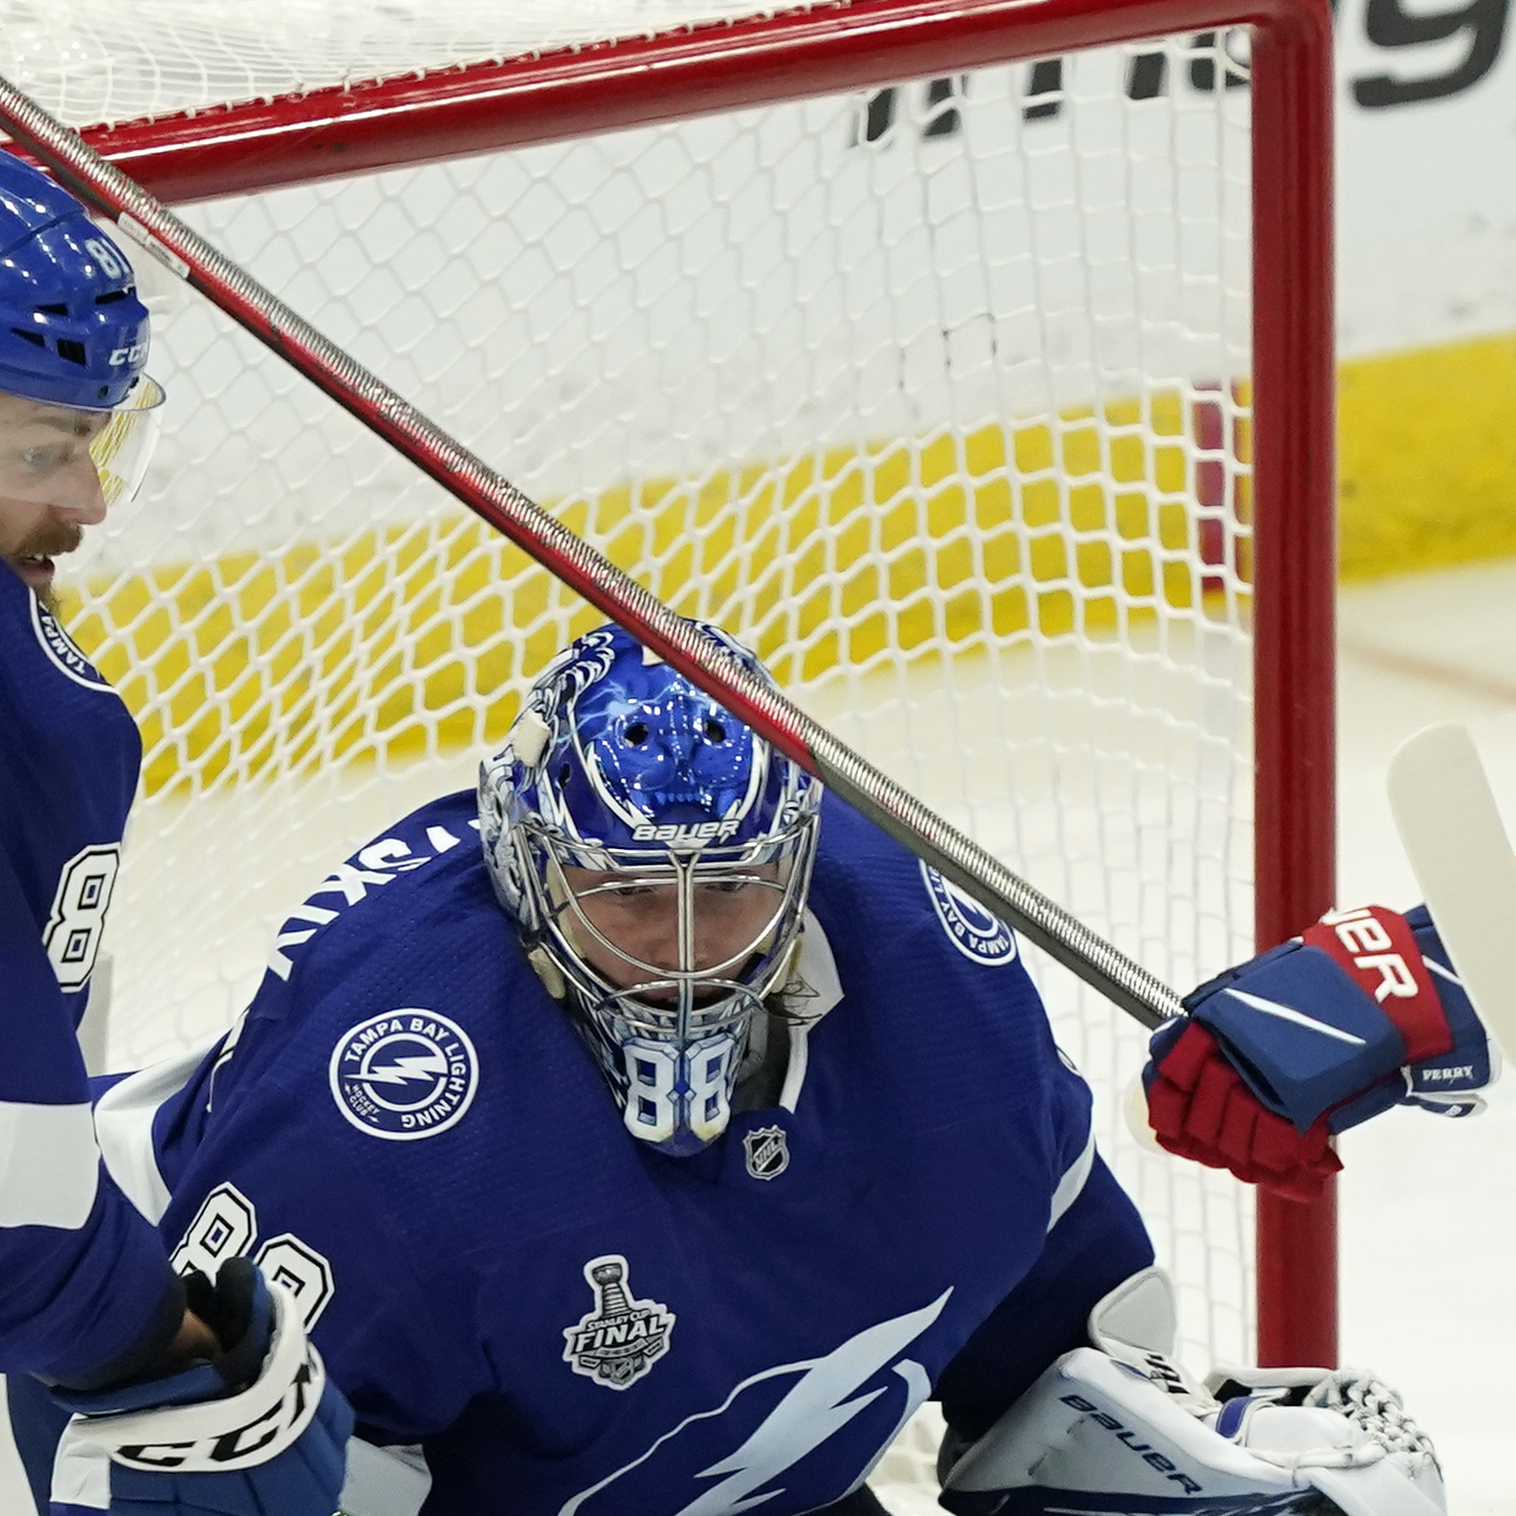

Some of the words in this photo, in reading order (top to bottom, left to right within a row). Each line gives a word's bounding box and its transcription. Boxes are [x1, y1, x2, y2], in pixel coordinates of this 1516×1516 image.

[631, 817, 741, 843] BAUER
[343, 1019, 403, 1063] TAMPA
[409, 1017, 450, 1043] BAY
[400, 1042, 467, 1129] LIGHTNING
[622, 1033, 736, 1143] 88
[1421, 1064, 1476, 1083] PERRY
[347, 1094, 370, 1118] CLUB
[351, 1082, 381, 1115] HOCKEY
[574, 1316, 666, 1353] FINAL
[1061, 1394, 1204, 1496] BAUER
